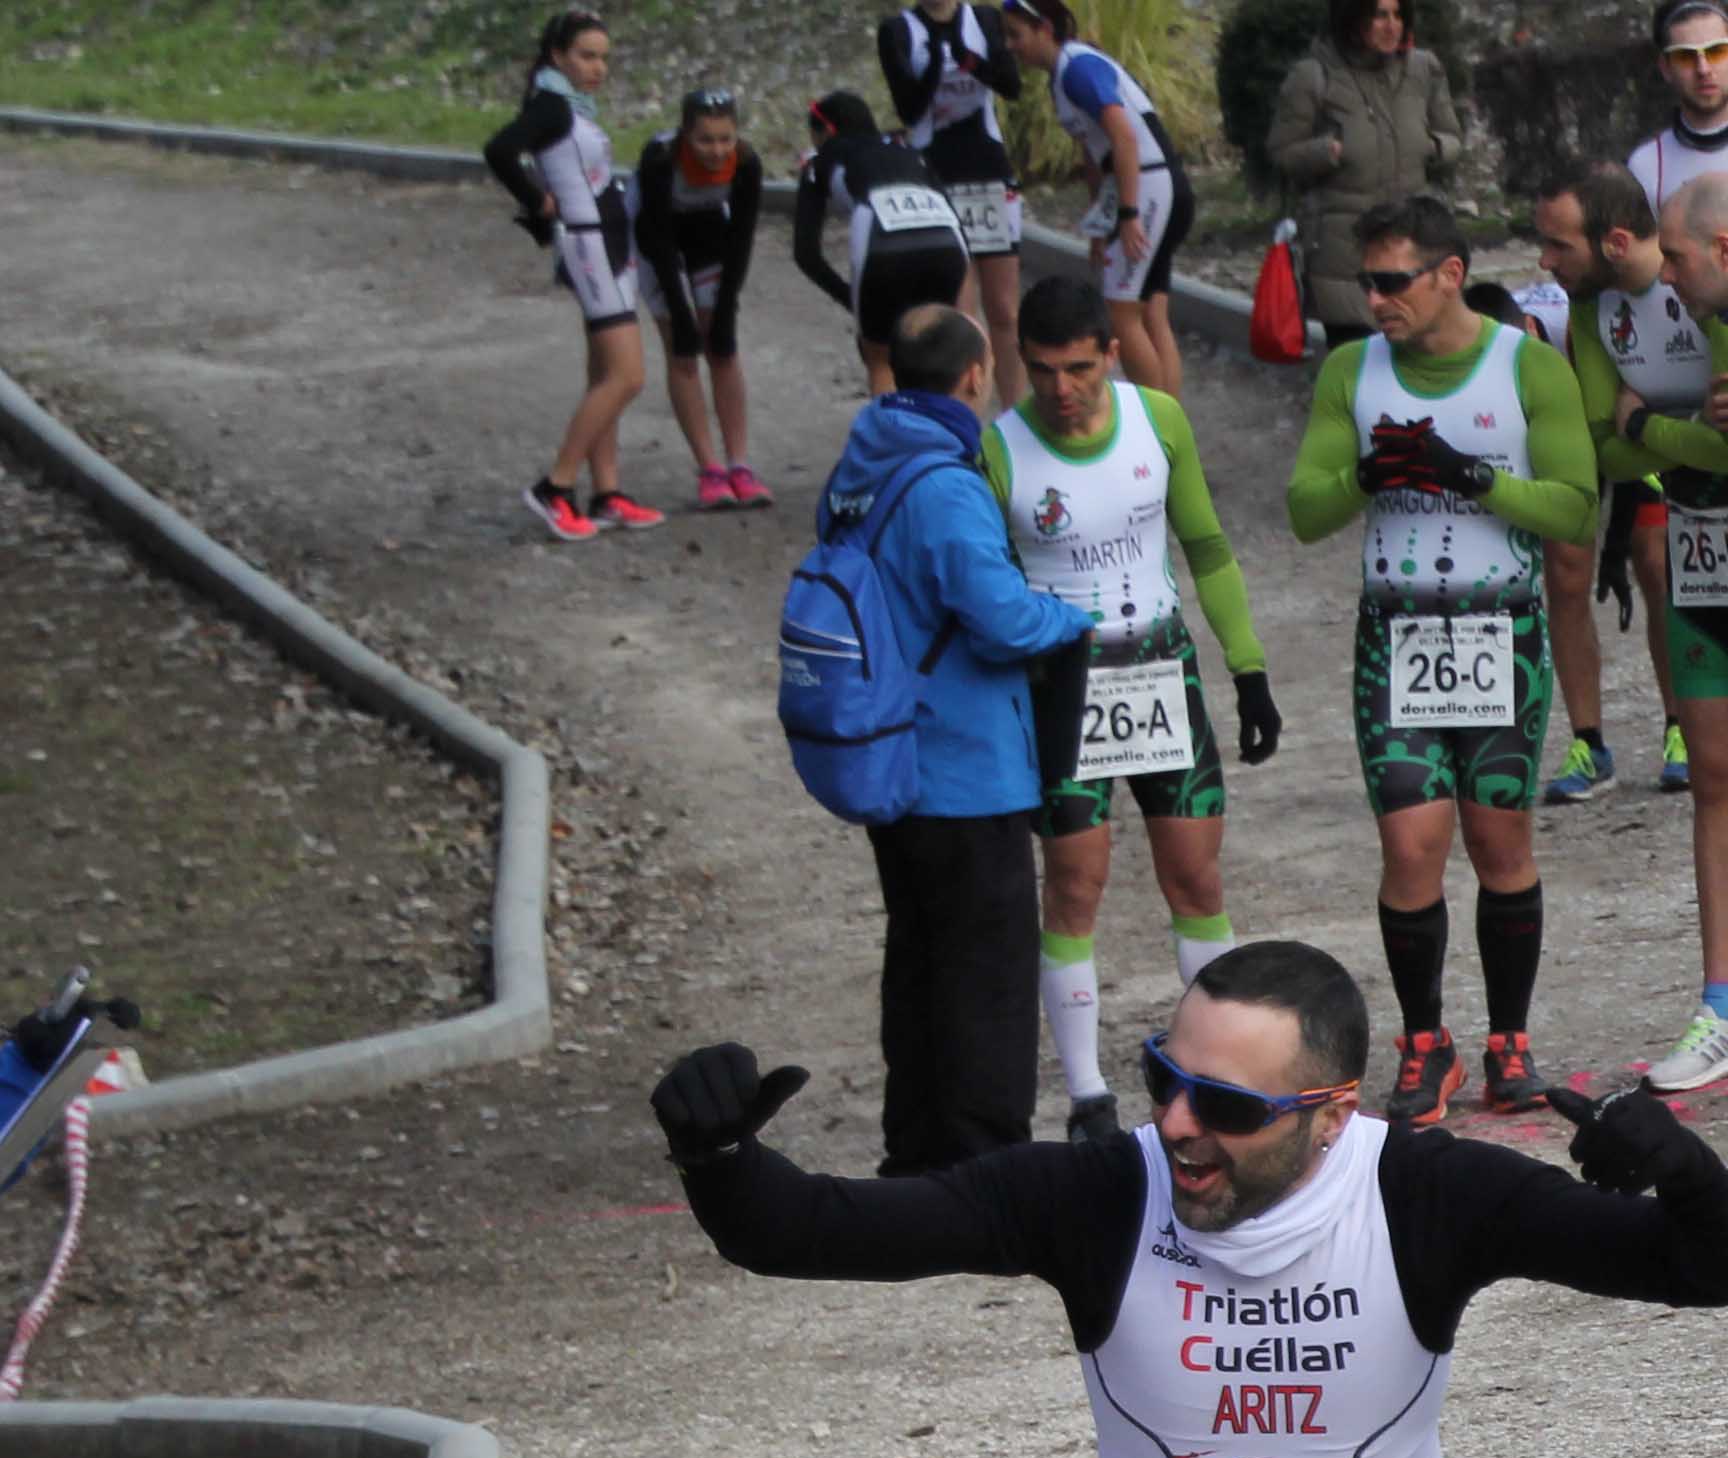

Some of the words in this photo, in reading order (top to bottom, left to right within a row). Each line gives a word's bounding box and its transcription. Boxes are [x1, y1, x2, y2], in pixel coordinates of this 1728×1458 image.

[961, 204, 1000, 231] 4-C
[1071, 529, 1143, 572] MARTÍN
[1408, 652, 1496, 693] 26-C
[1083, 698, 1174, 745] 26-A
[1400, 701, 1506, 716] dorsalia.com
[1175, 1280, 1360, 1326] Triatlón
[1179, 1335, 1356, 1373] Cuéllar
[1211, 1384, 1328, 1434] ARITZ
